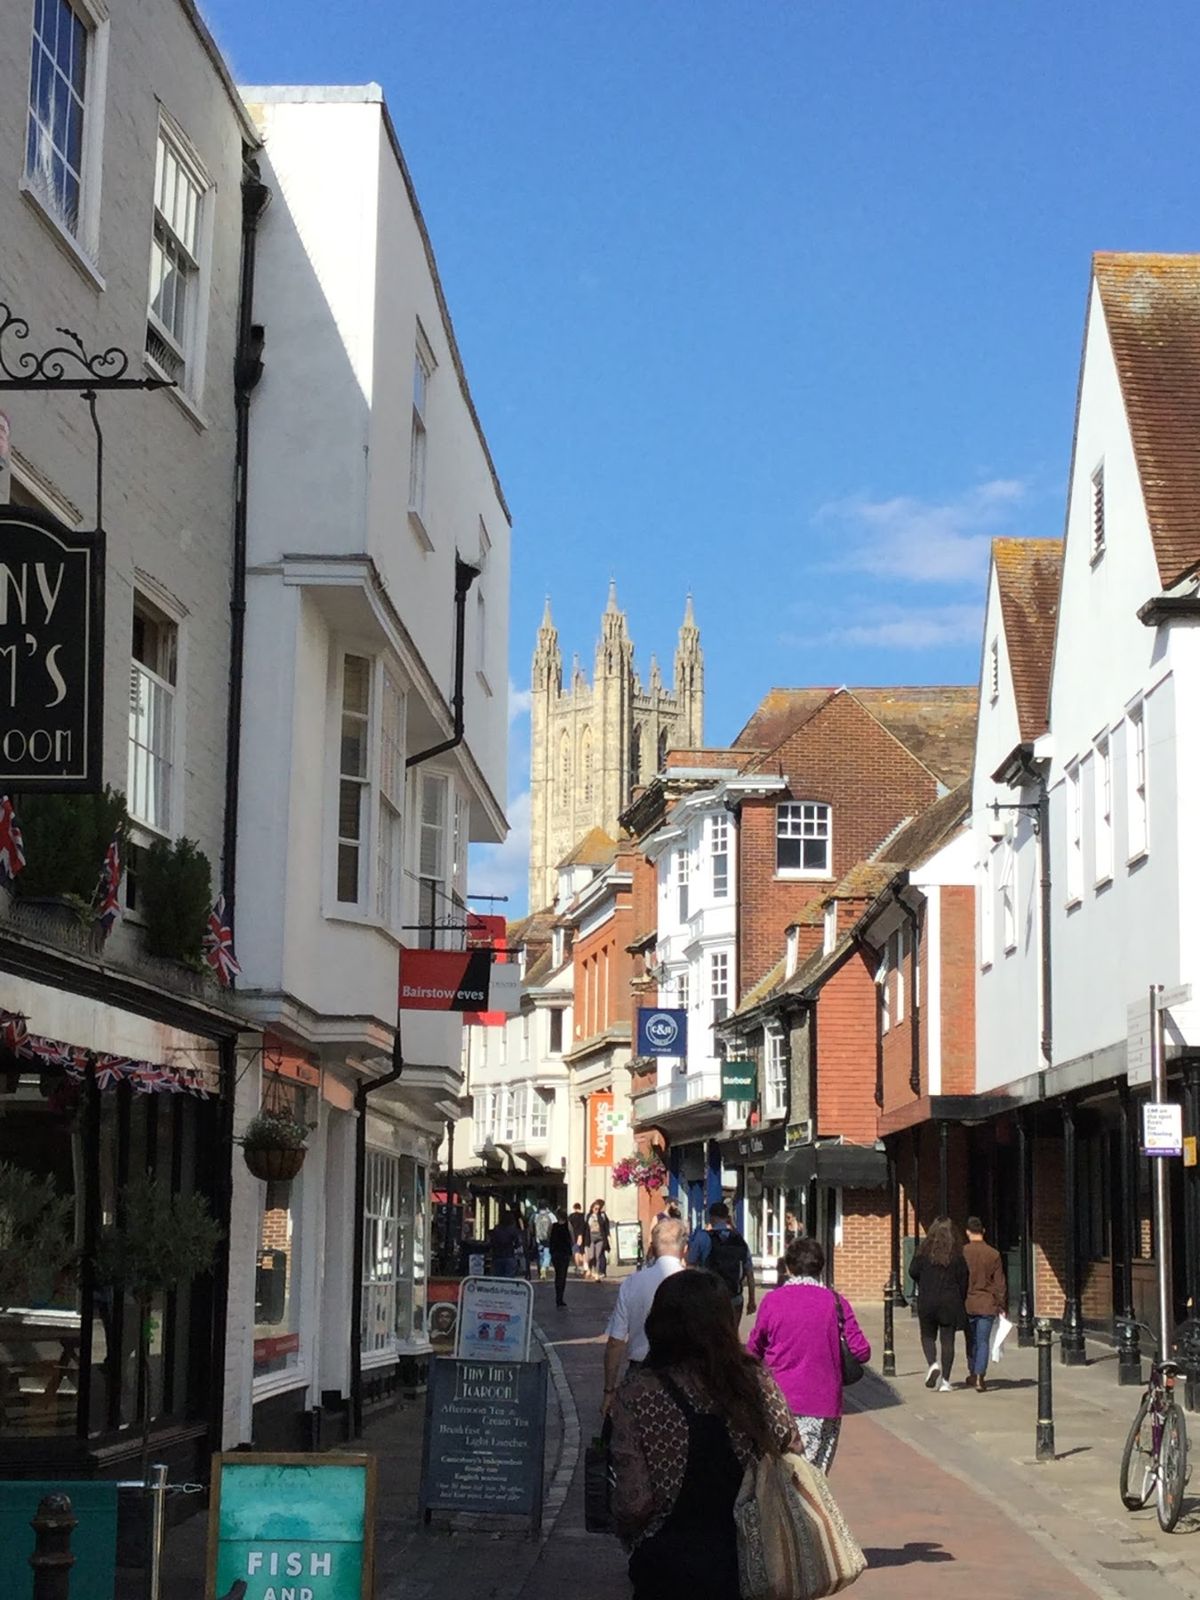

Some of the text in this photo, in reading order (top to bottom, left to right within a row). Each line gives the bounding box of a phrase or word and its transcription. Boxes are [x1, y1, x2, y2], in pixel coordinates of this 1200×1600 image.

[3, 729, 72, 762] OOM
[402, 984, 485, 1001] Bairstow eves
[723, 1076, 753, 1086] Barbour
[441, 1402, 487, 1415] Afternoon
[482, 1415, 511, 1426] Cream
[440, 1424, 481, 1435] Breakfast
[466, 1436, 528, 1448] Light Lunches
[247, 1551, 332, 1577] FISH
[263, 1587, 314, 1600] AND
